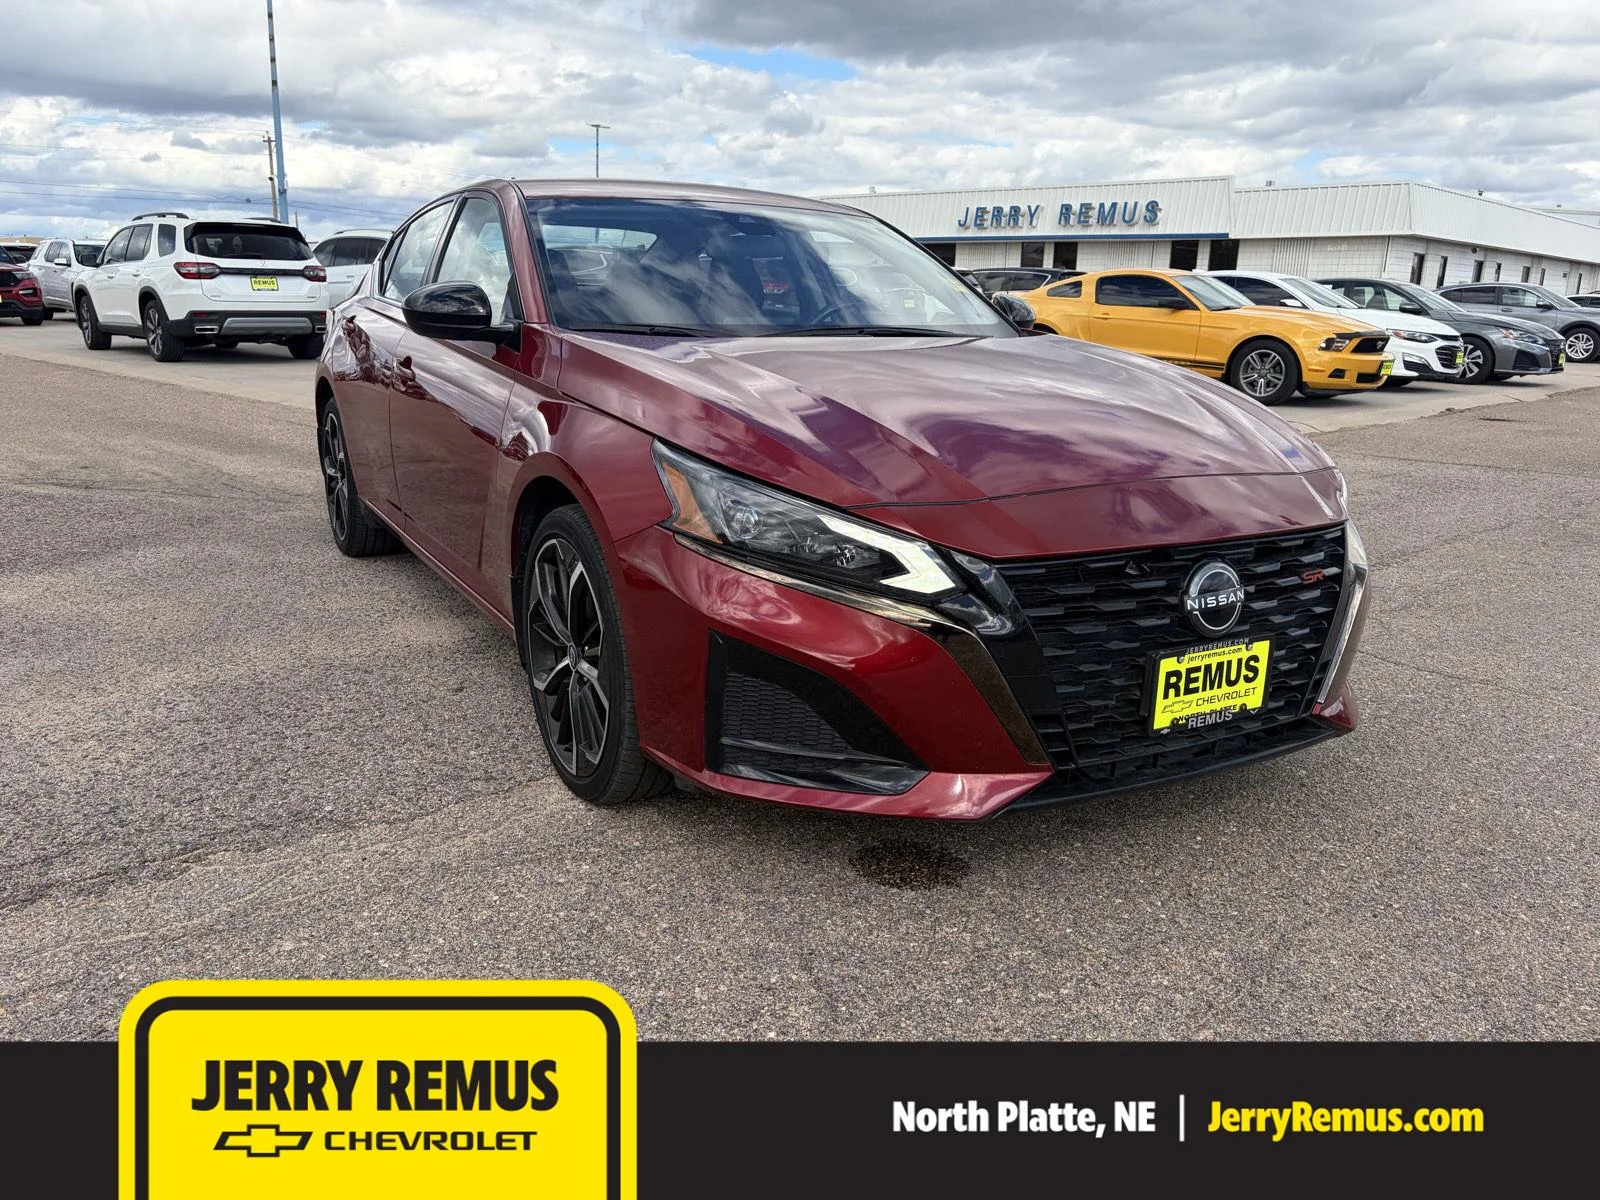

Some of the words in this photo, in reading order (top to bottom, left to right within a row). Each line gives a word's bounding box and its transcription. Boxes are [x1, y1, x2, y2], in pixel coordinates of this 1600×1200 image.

[958, 204, 1041, 228] JERRY
[1058, 200, 1161, 225] REMUS
[1302, 568, 1325, 584] SR
[1187, 589, 1245, 611] NISSAN
[1186, 638, 1250, 655] JERRYREMUS.COM
[1187, 647, 1243, 664] jerryremus.com
[1162, 655, 1260, 701] REMUS
[1196, 687, 1258, 707] CHEVROLET
[1188, 710, 1233, 729] REMUS
